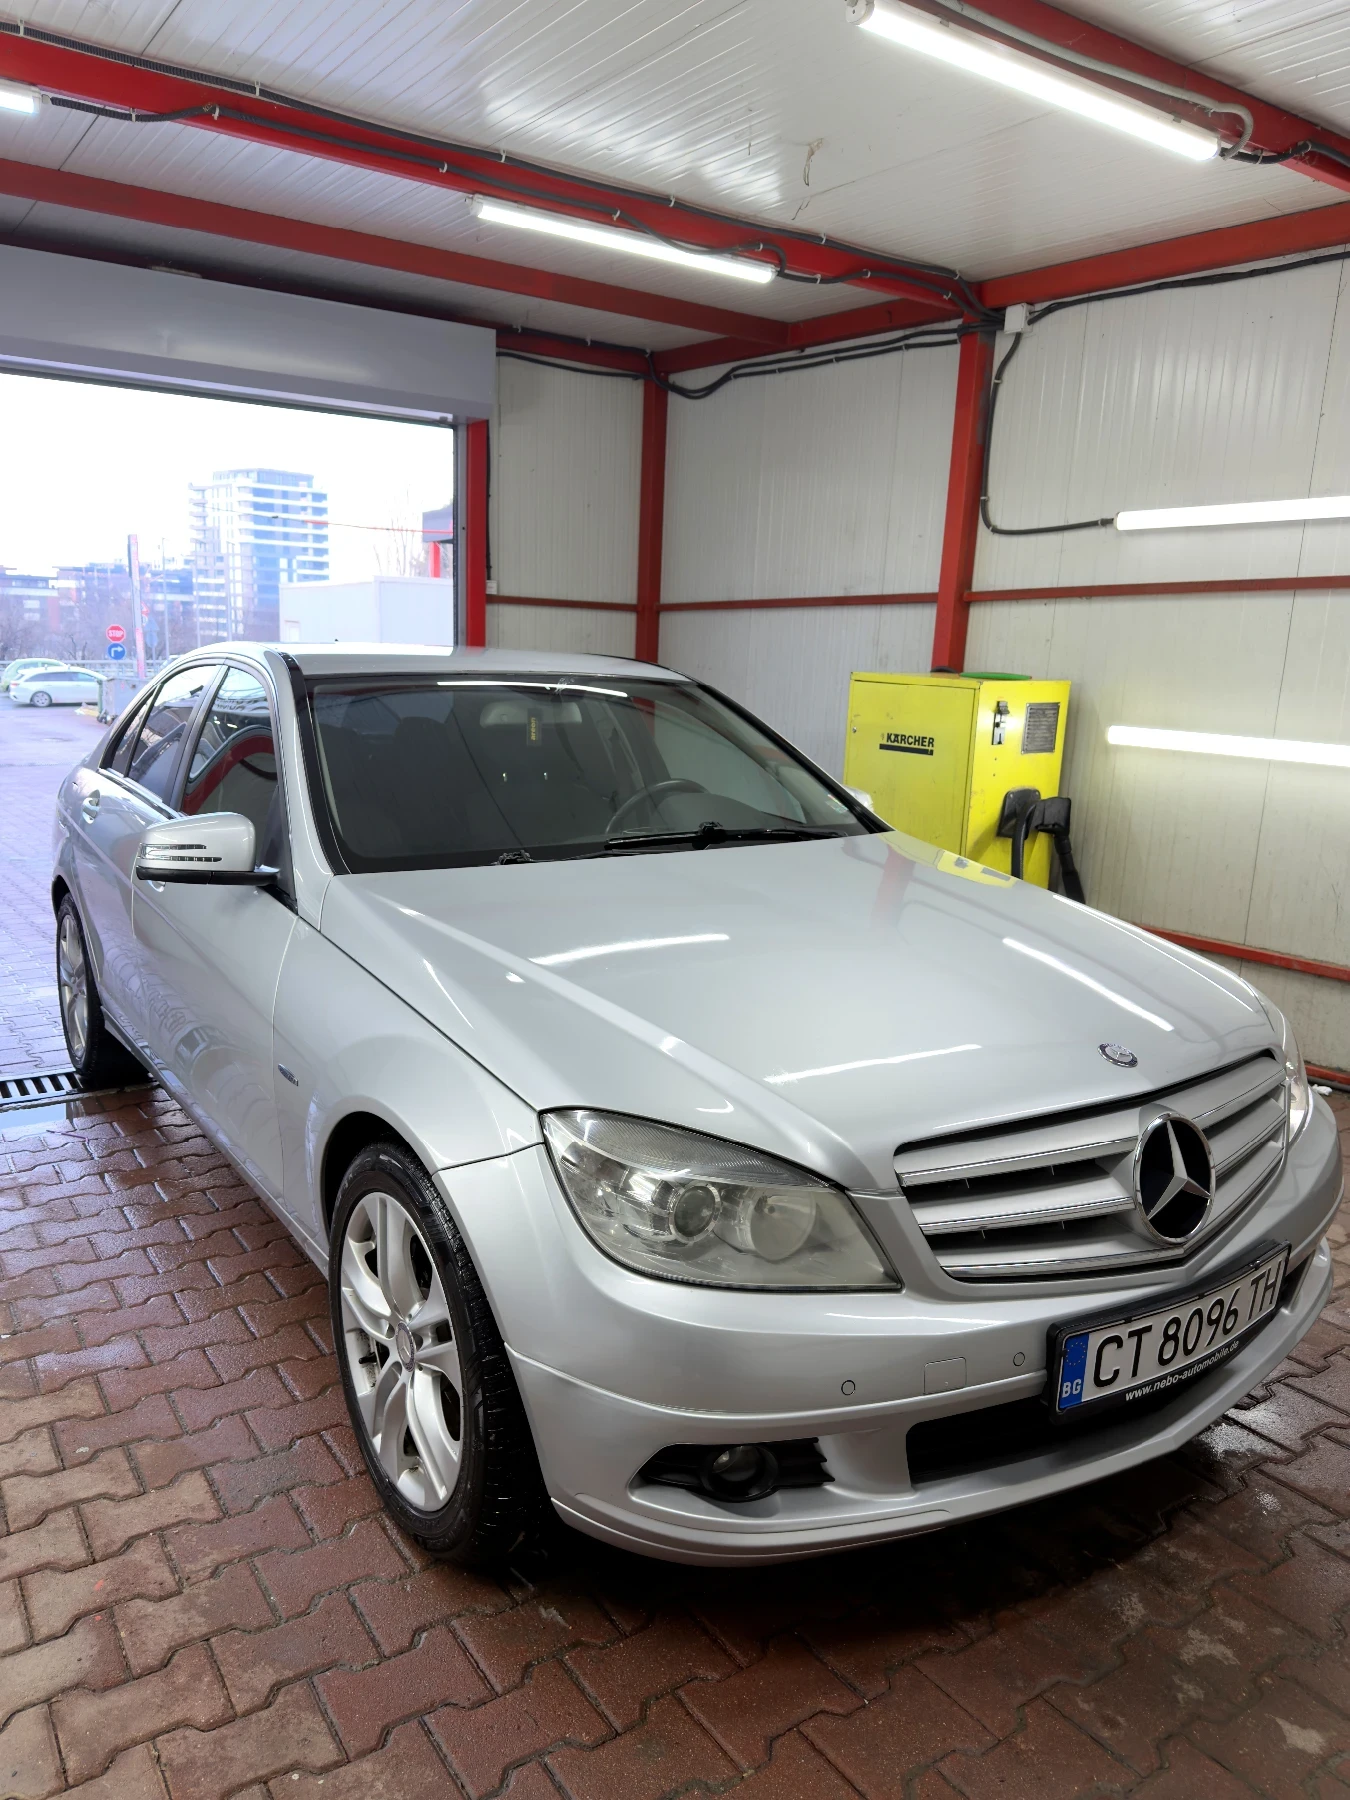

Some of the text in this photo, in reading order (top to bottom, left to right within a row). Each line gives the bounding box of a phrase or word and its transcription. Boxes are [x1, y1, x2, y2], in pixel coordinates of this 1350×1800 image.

[108, 629, 124, 638] STOP
[1062, 1260, 1282, 1398] BG CT 8096 TH
[1125, 1340, 1240, 1401] www.nebo-automobile.de
